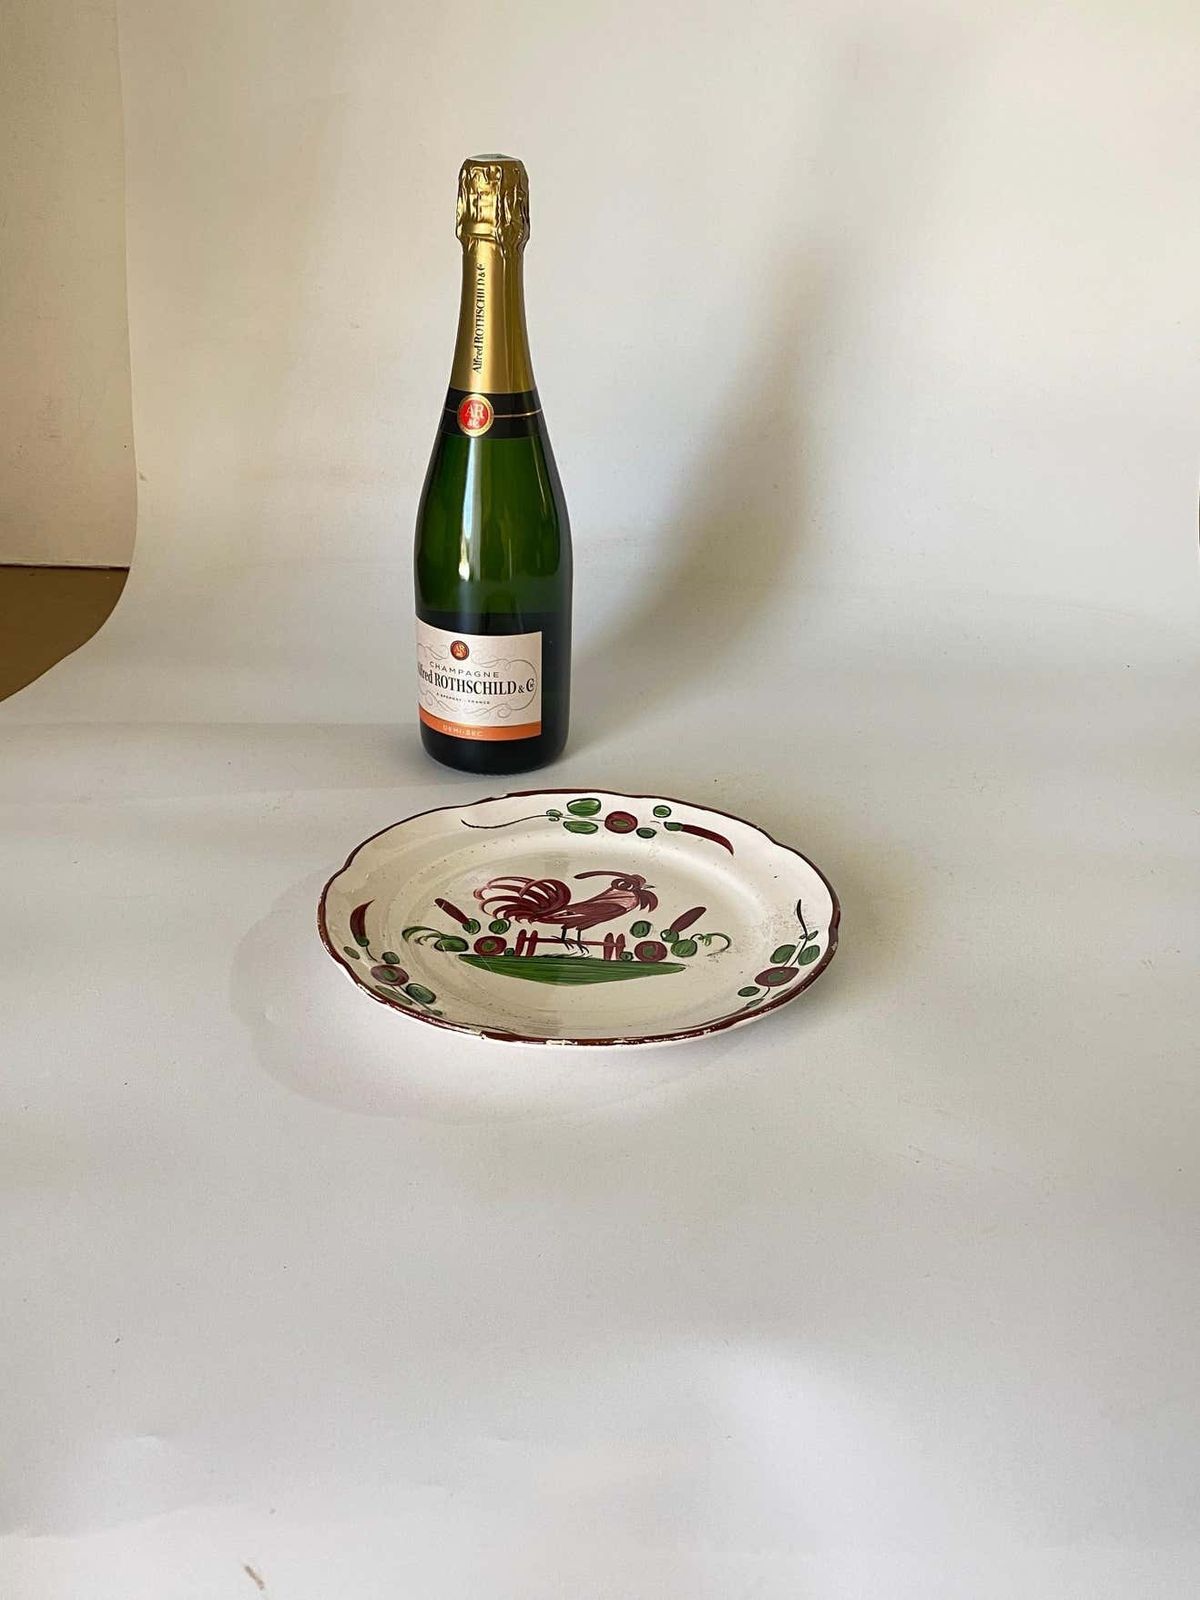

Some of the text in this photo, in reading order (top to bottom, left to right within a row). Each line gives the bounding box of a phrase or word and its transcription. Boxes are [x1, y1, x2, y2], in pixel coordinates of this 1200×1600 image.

[474, 278, 486, 344] ROTHSCHILD
[473, 346, 484, 375] Alfred
[429, 661, 500, 679] CHAMPAGNE
[434, 672, 517, 695] ROTHSCHILD
[518, 684, 525, 694] &
